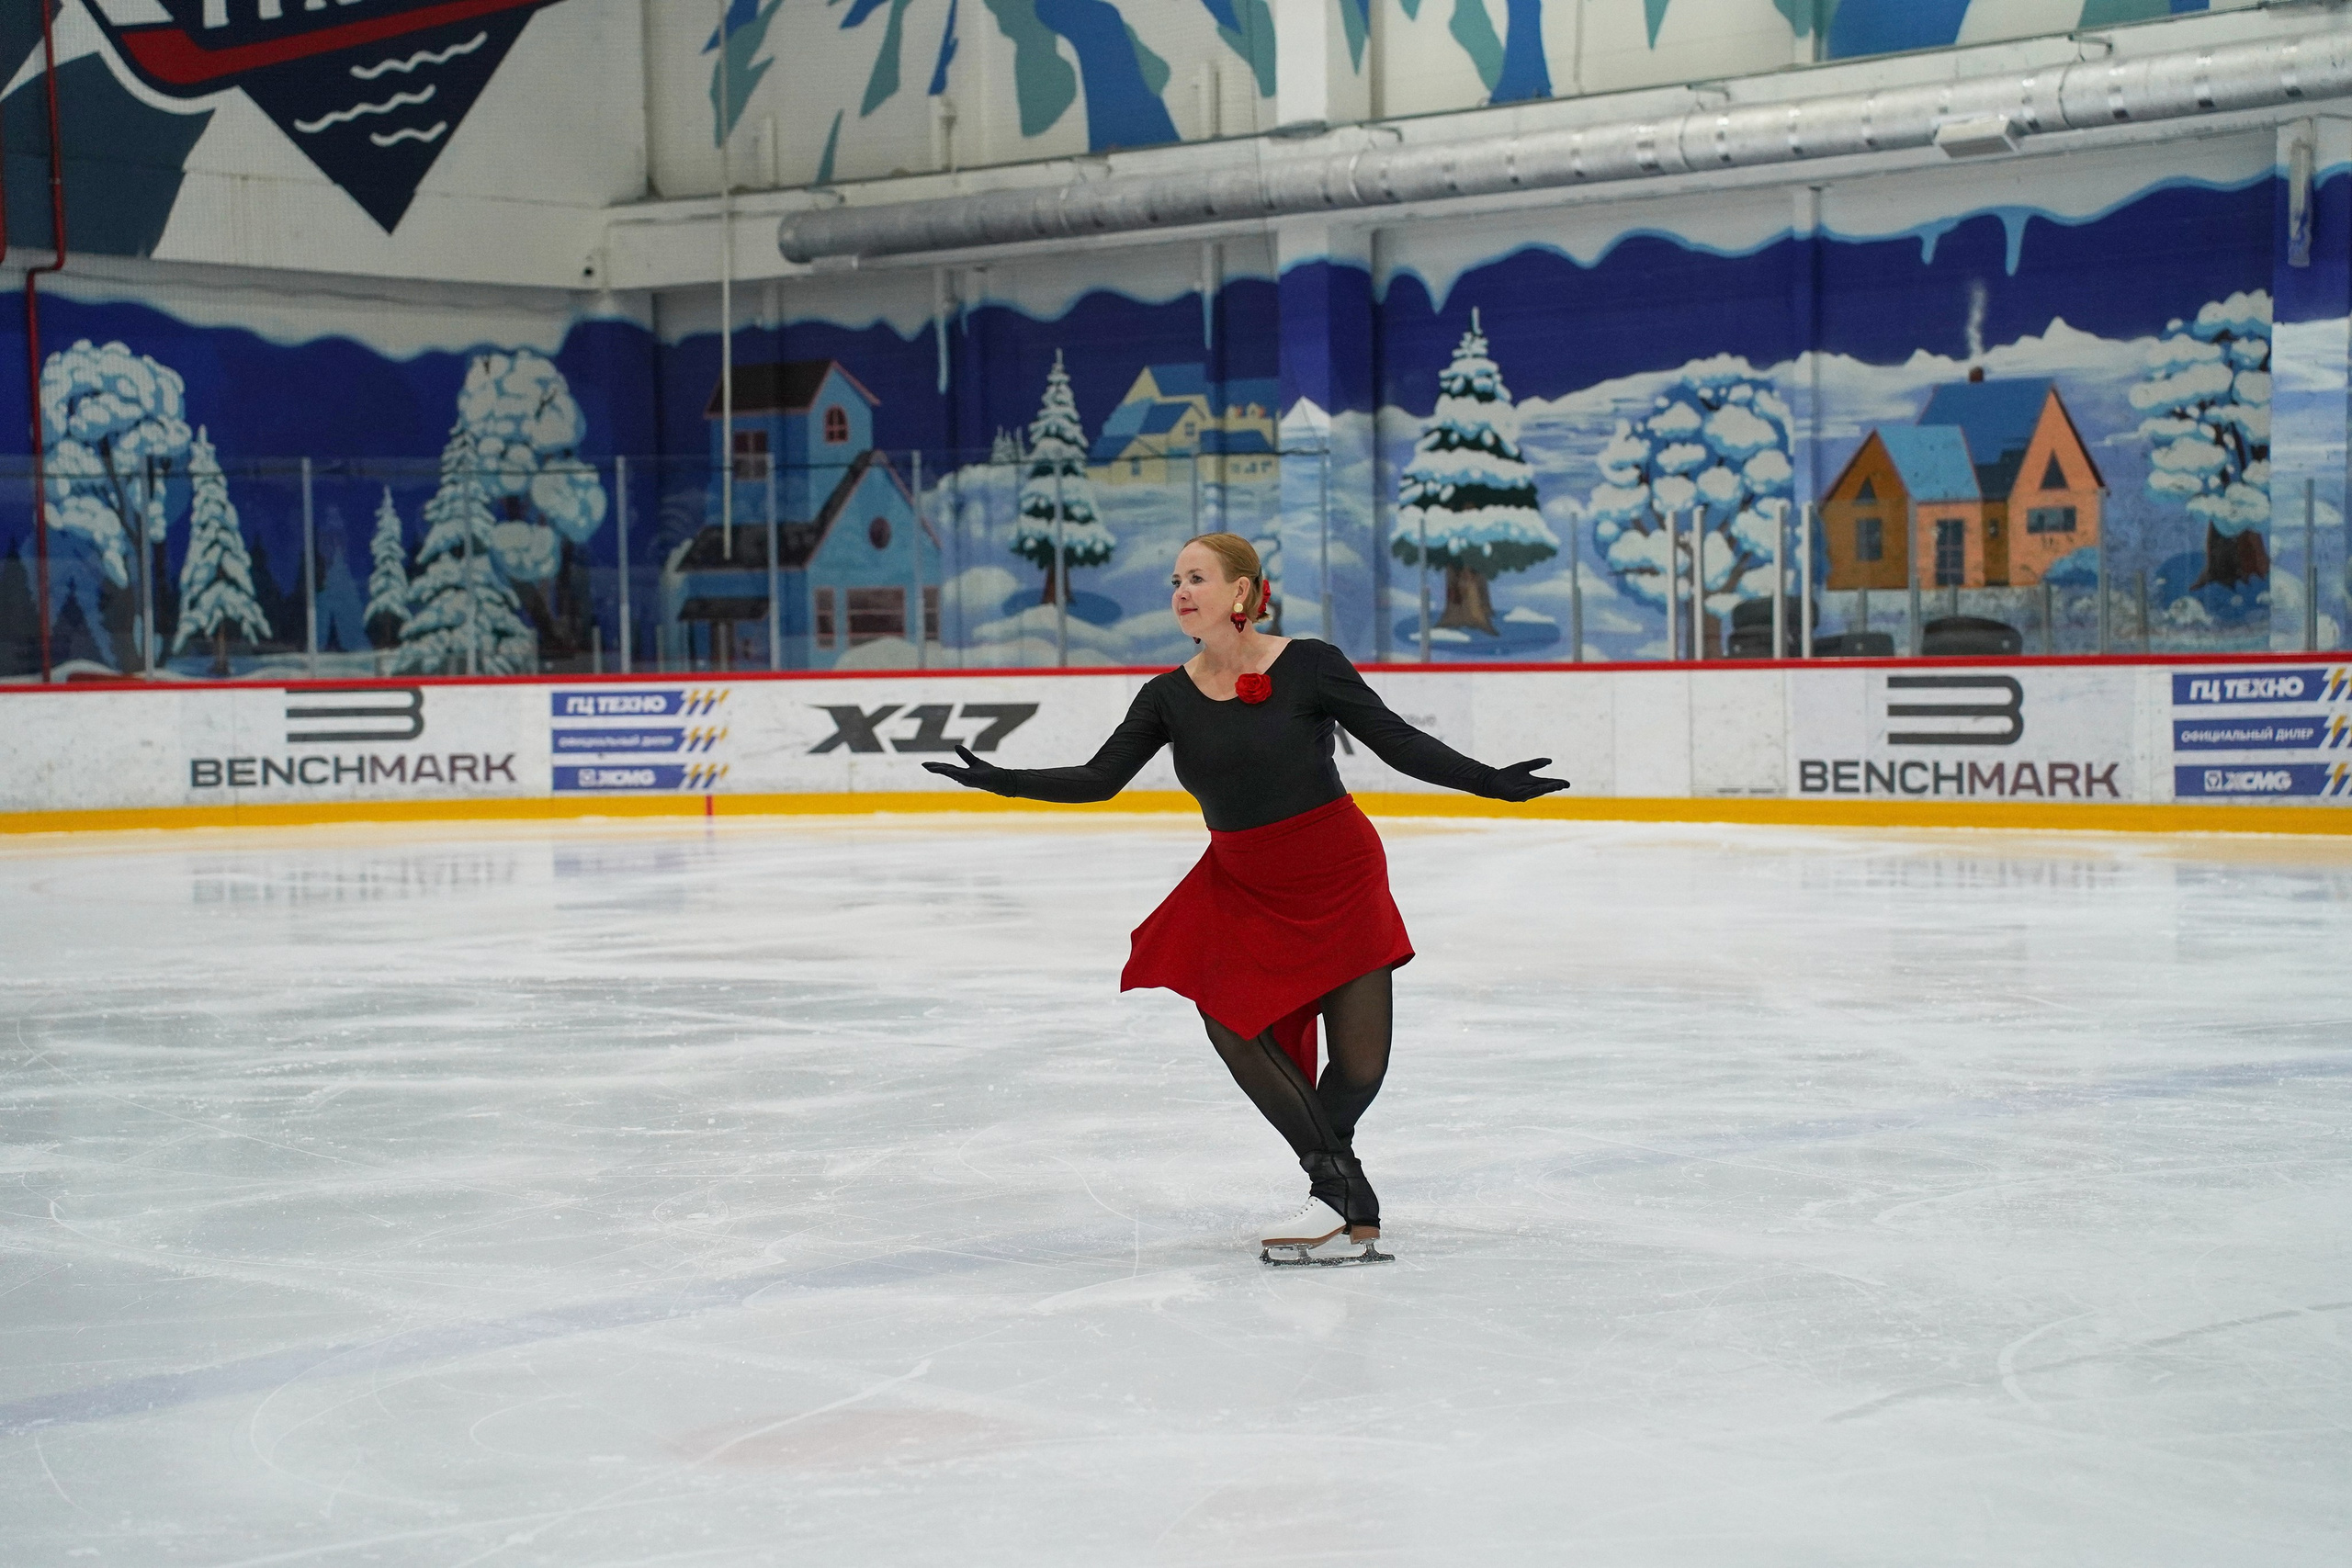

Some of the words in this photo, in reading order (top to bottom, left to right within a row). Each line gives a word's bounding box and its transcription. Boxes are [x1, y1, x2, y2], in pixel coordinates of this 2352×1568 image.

[2189, 680, 2221, 702] ГЦ
[2223, 676, 2304, 699] ТЕХНО
[805, 702, 1041, 753] X17
[2181, 727, 2273, 743] ОФИЦИАЛЬНЫЙ
[2275, 728, 2314, 742] ДИЛЕР
[190, 752, 516, 787] BENCHMARK
[1799, 760, 2121, 797] BENCHMARK
